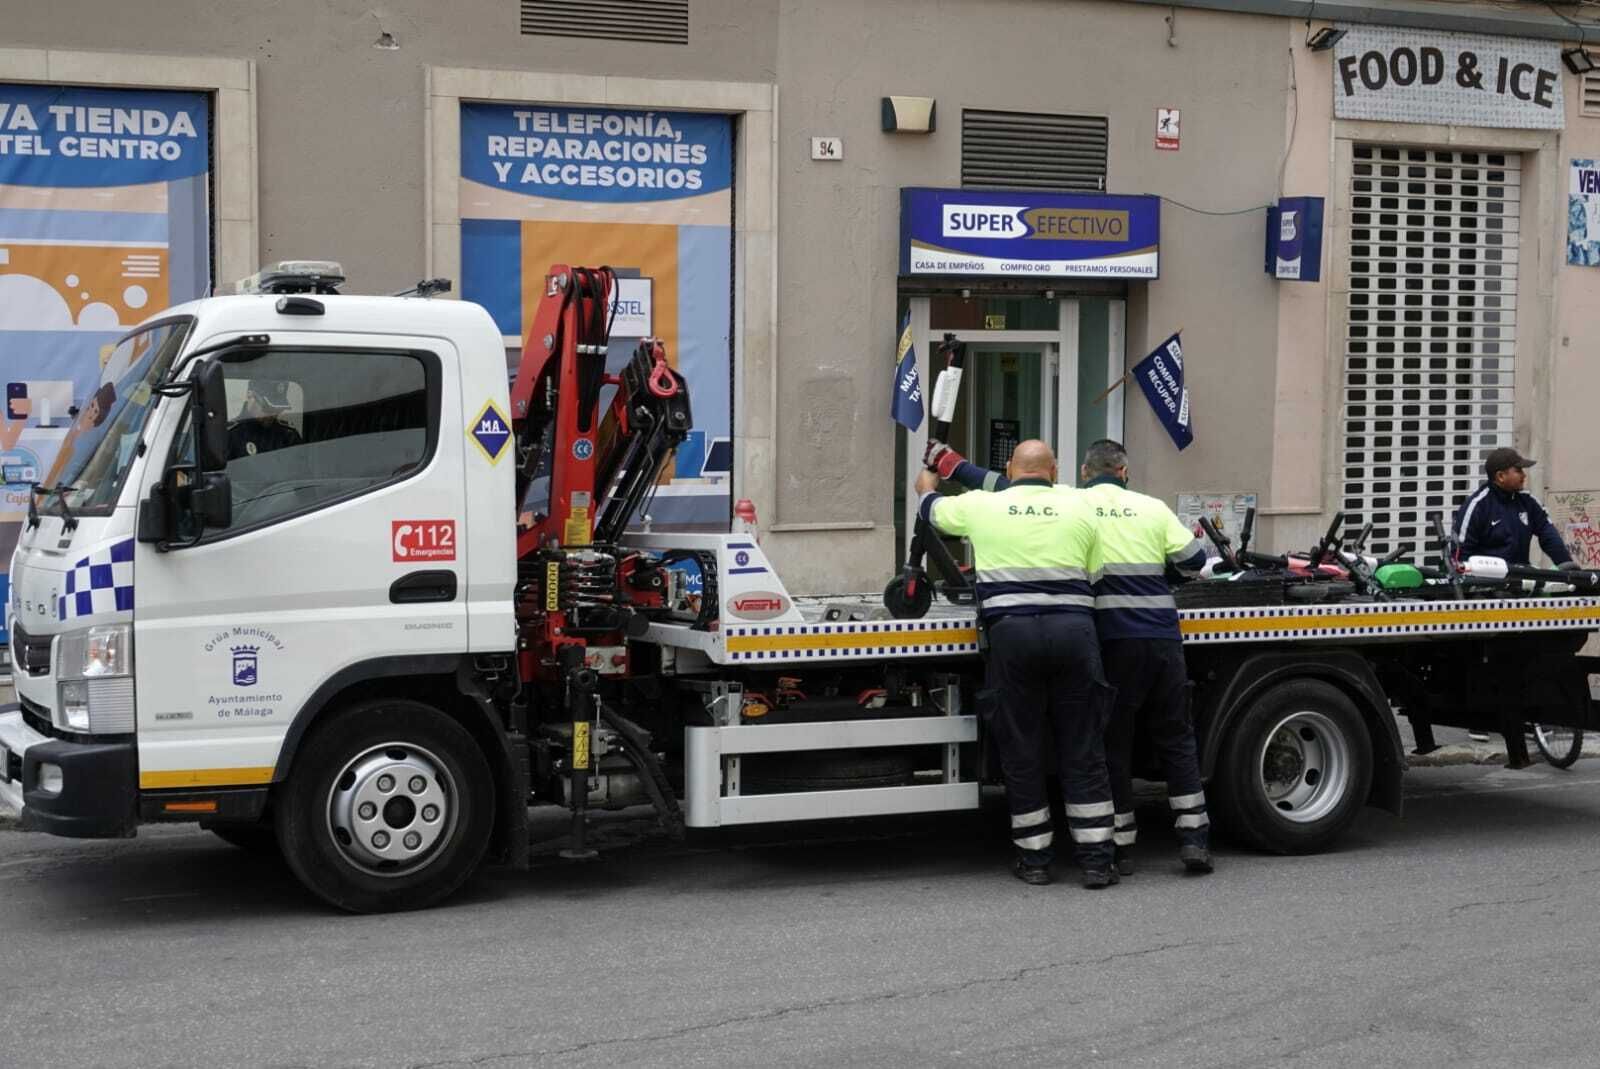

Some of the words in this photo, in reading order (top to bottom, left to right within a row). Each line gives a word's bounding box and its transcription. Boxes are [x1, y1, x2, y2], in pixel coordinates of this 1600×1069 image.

[1338, 47, 1444, 96] FOOD
[1456, 51, 1483, 90] &
[1496, 57, 1557, 109] ICE
[49, 105, 197, 137] TIENDA
[514, 111, 682, 142] TELEFONÍA,
[59, 136, 182, 161] CENTRO
[488, 136, 707, 165] REPARACIONES
[820, 142, 834, 156] 94
[493, 162, 512, 182] Y
[521, 163, 702, 190] ACCESORIOS
[950, 213, 1014, 232] SUPER
[1037, 215, 1122, 236] EFECTIVO
[915, 261, 936, 270] CASA
[937, 262, 947, 270] DE
[949, 260, 985, 271] EMPEÑOS
[1000, 263, 1033, 272] COMPRO
[1034, 264, 1051, 272] ORO
[1065, 264, 1107, 273] PRESTAMOS
[1109, 265, 1153, 274] PERSONALES
[1153, 355, 1180, 395] COMPRA
[1147, 368, 1176, 413] RECUPER
[1008, 505, 1058, 516] S.A.C.
[1095, 507, 1137, 518] S.A.C.
[415, 525, 453, 546] 112
[205, 632, 229, 651] Grúa
[233, 627, 285, 650] Municipal
[208, 694, 282, 705] Ayuntamiento
[218, 708, 231, 718] de
[234, 708, 273, 718] Málaga
